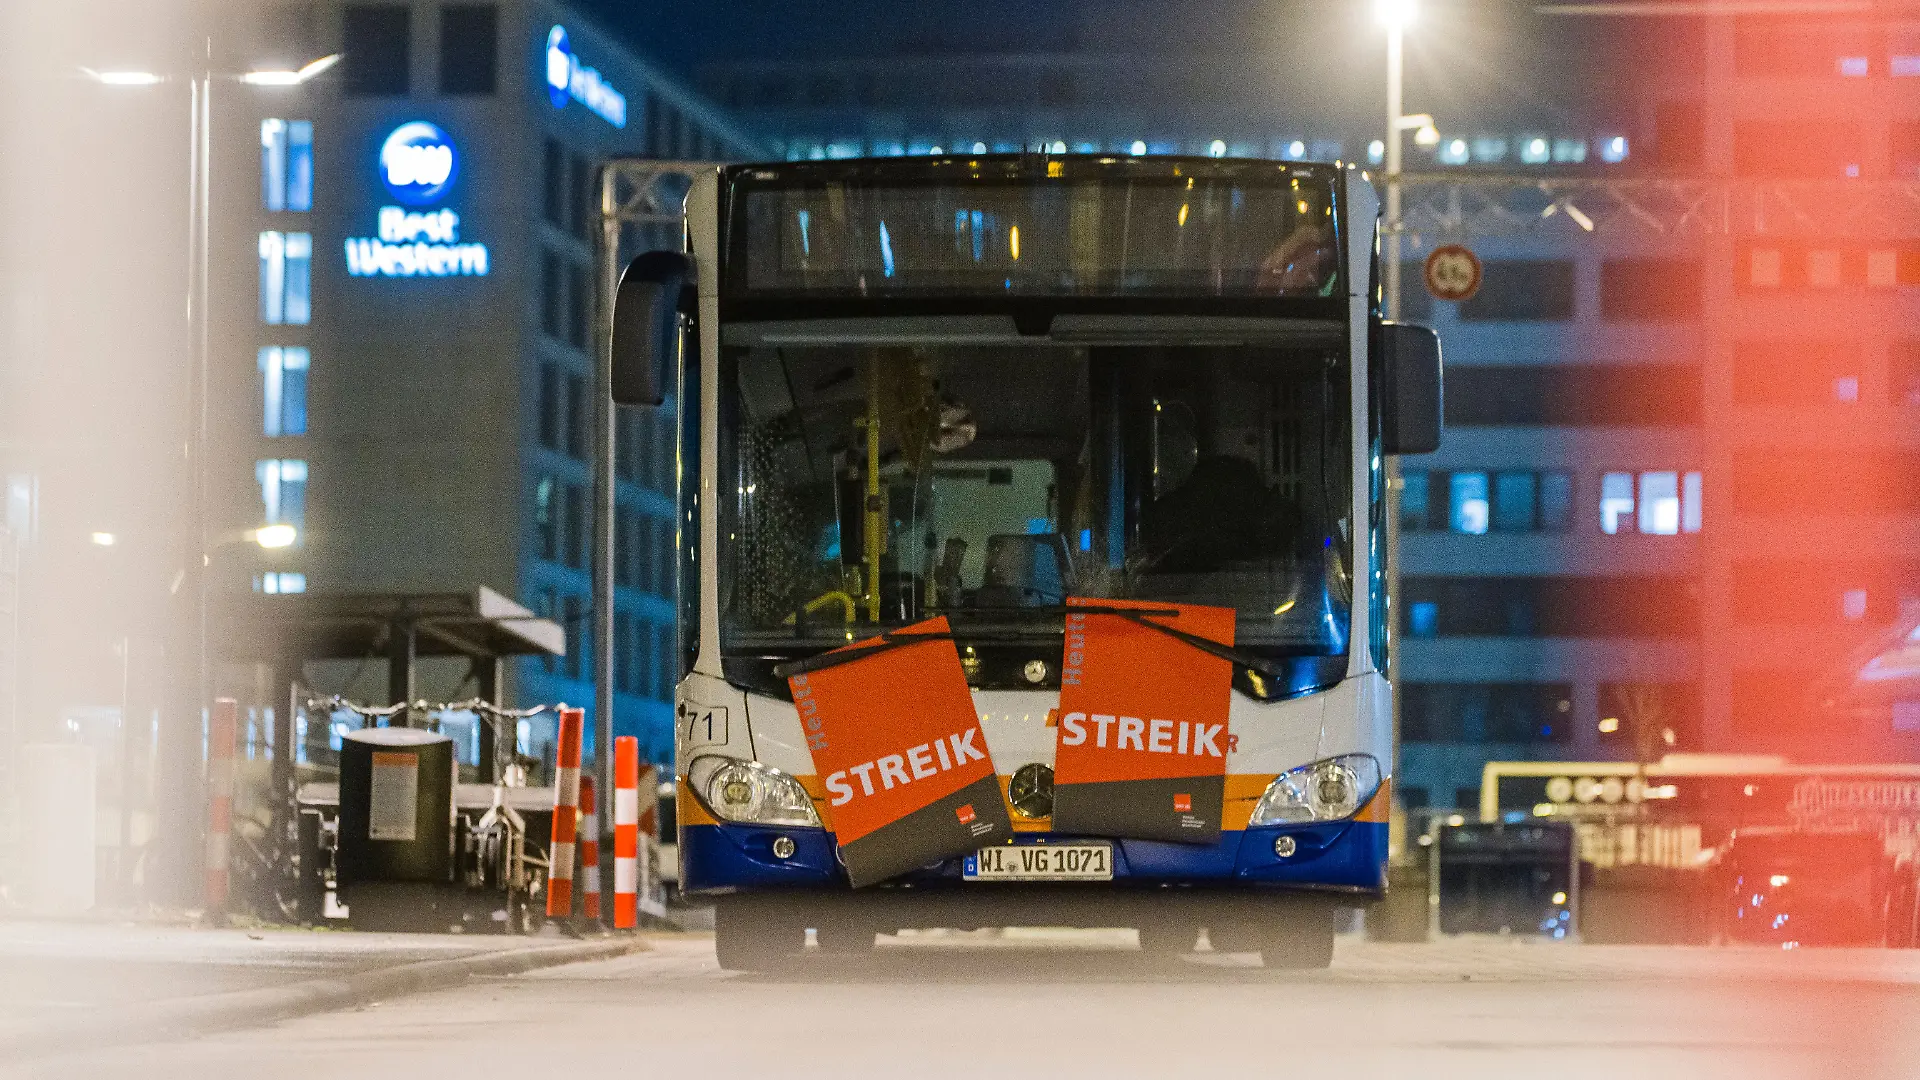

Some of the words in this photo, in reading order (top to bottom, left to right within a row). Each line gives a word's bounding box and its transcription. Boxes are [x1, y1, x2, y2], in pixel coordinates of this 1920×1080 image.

[378, 205, 460, 243] Best
[345, 237, 491, 277] Western
[1062, 712, 1225, 758] STREIK
[825, 727, 985, 807] STREIK
[968, 864, 974, 872] D
[980, 849, 1004, 872] WI
[1021, 849, 1048, 872] VG
[1054, 849, 1105, 872] 1071
